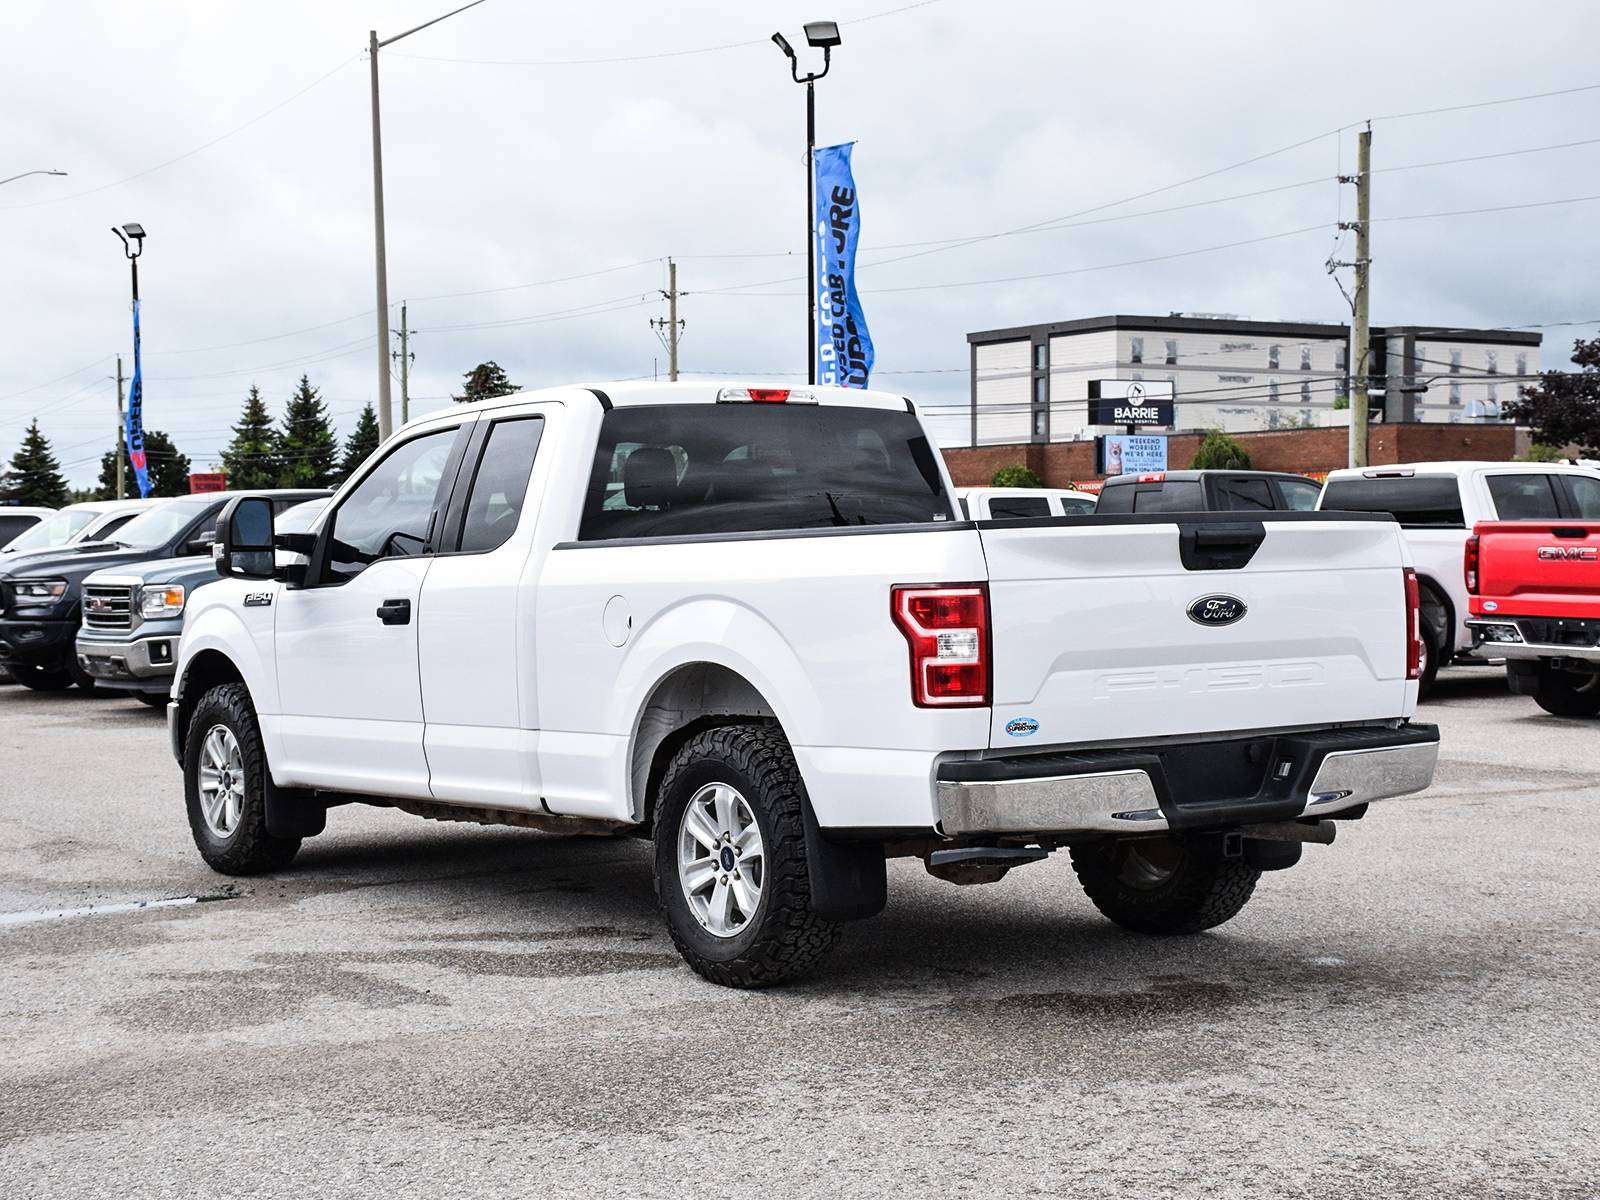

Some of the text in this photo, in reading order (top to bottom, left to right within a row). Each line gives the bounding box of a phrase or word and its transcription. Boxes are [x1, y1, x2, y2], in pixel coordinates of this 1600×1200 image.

[1114, 407, 1159, 419] BARRIE
[1537, 546, 1598, 561] GMC
[1203, 599, 1235, 619] Ford
[1093, 661, 1325, 700] F-150
